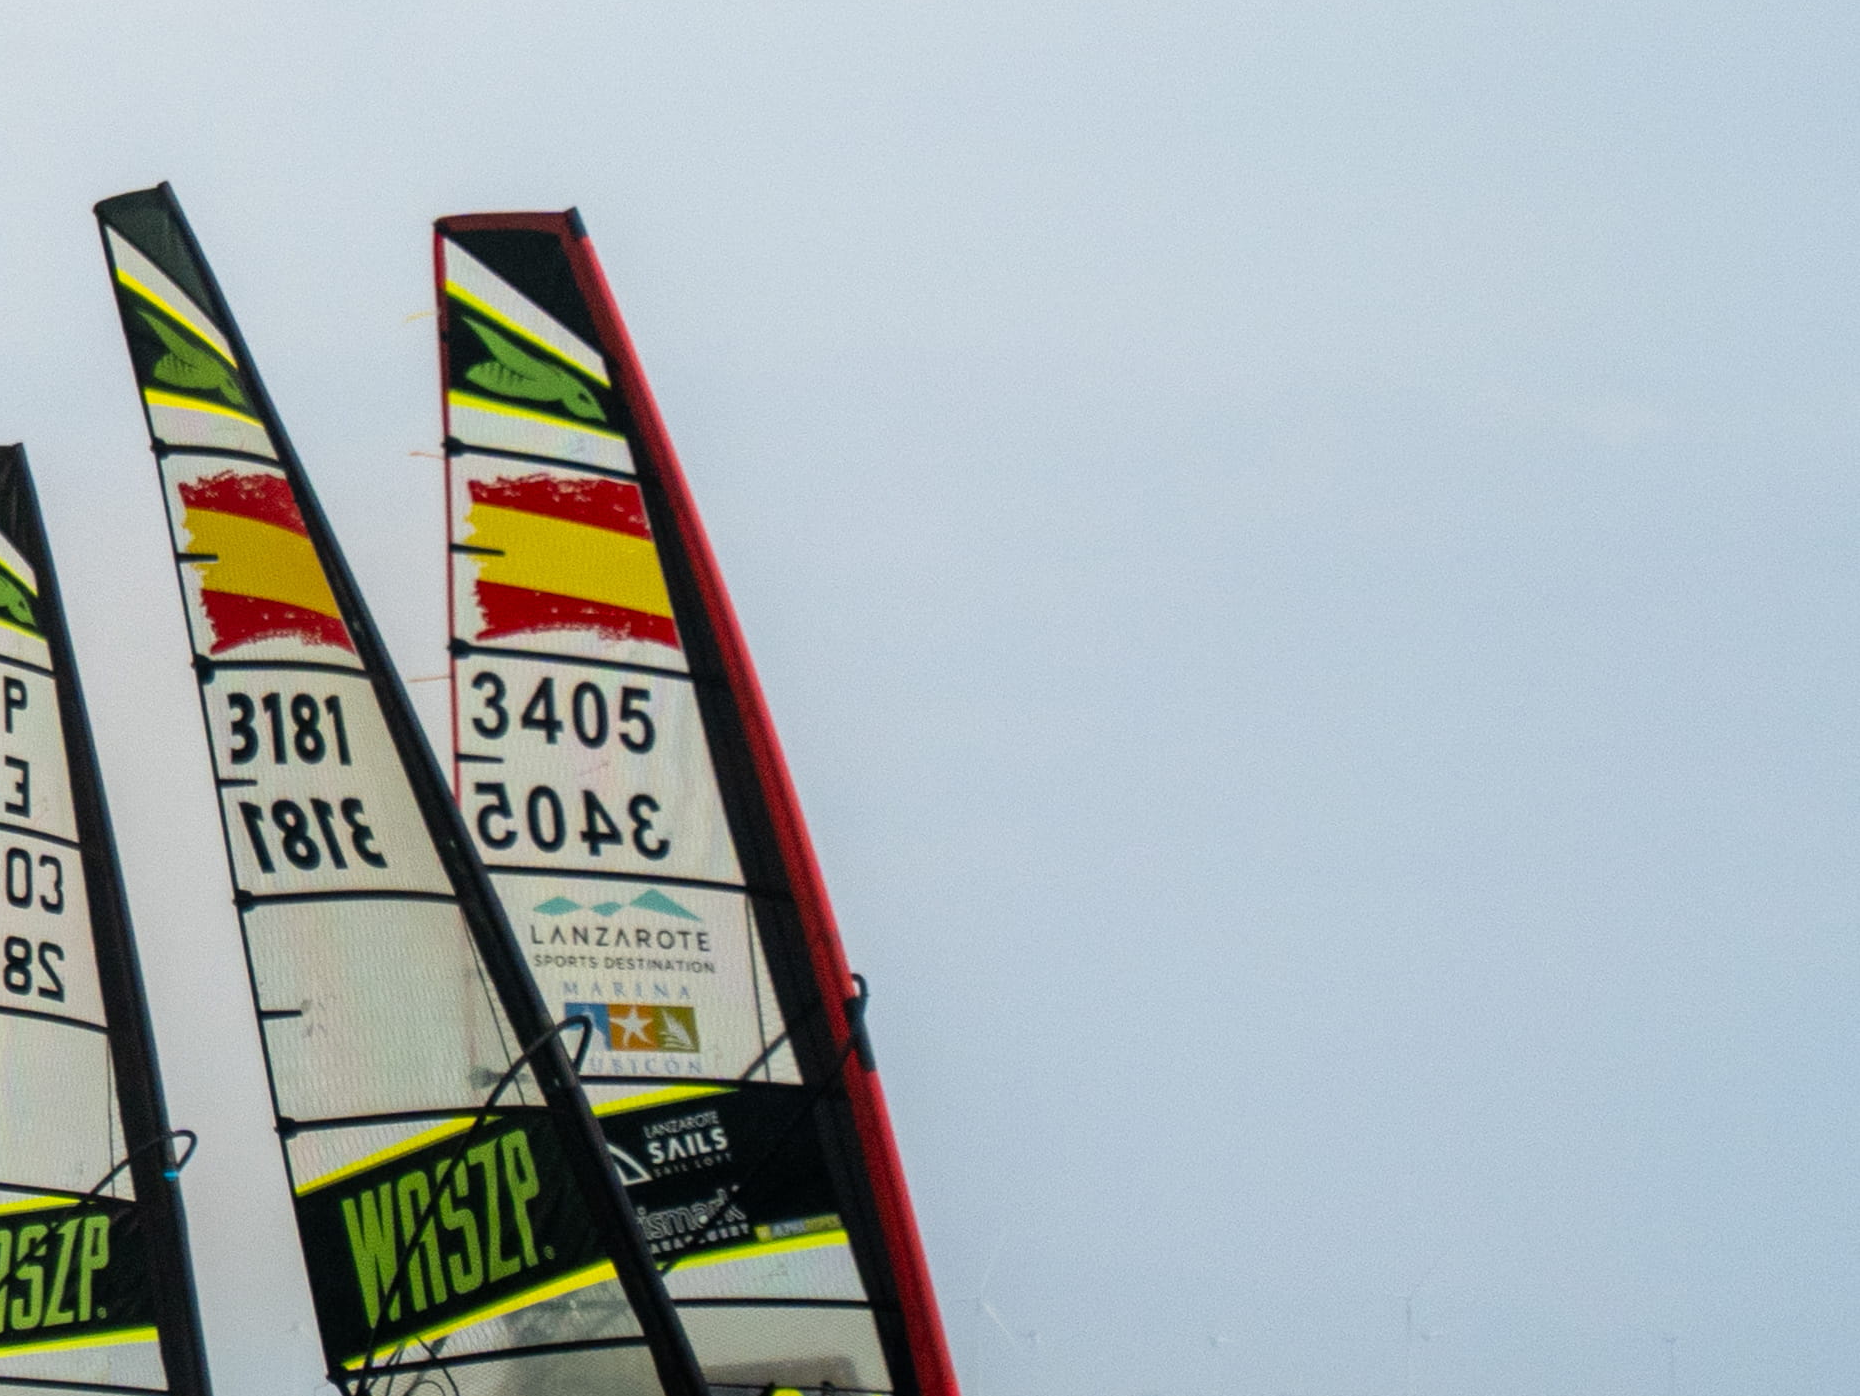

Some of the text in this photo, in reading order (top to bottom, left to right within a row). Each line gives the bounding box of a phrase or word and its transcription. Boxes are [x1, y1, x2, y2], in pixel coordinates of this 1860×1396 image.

[226, 691, 352, 767] 3181
[470, 671, 657, 755] 3405
[530, 924, 712, 952] LANZAROTE
[533, 954, 717, 974] SPORTS DESTINATION
[563, 981, 692, 1000] MARINA
[643, 1110, 720, 1139] LANZAROTE
[647, 1127, 728, 1165] SAILS
[341, 1129, 542, 1329] WASZP
